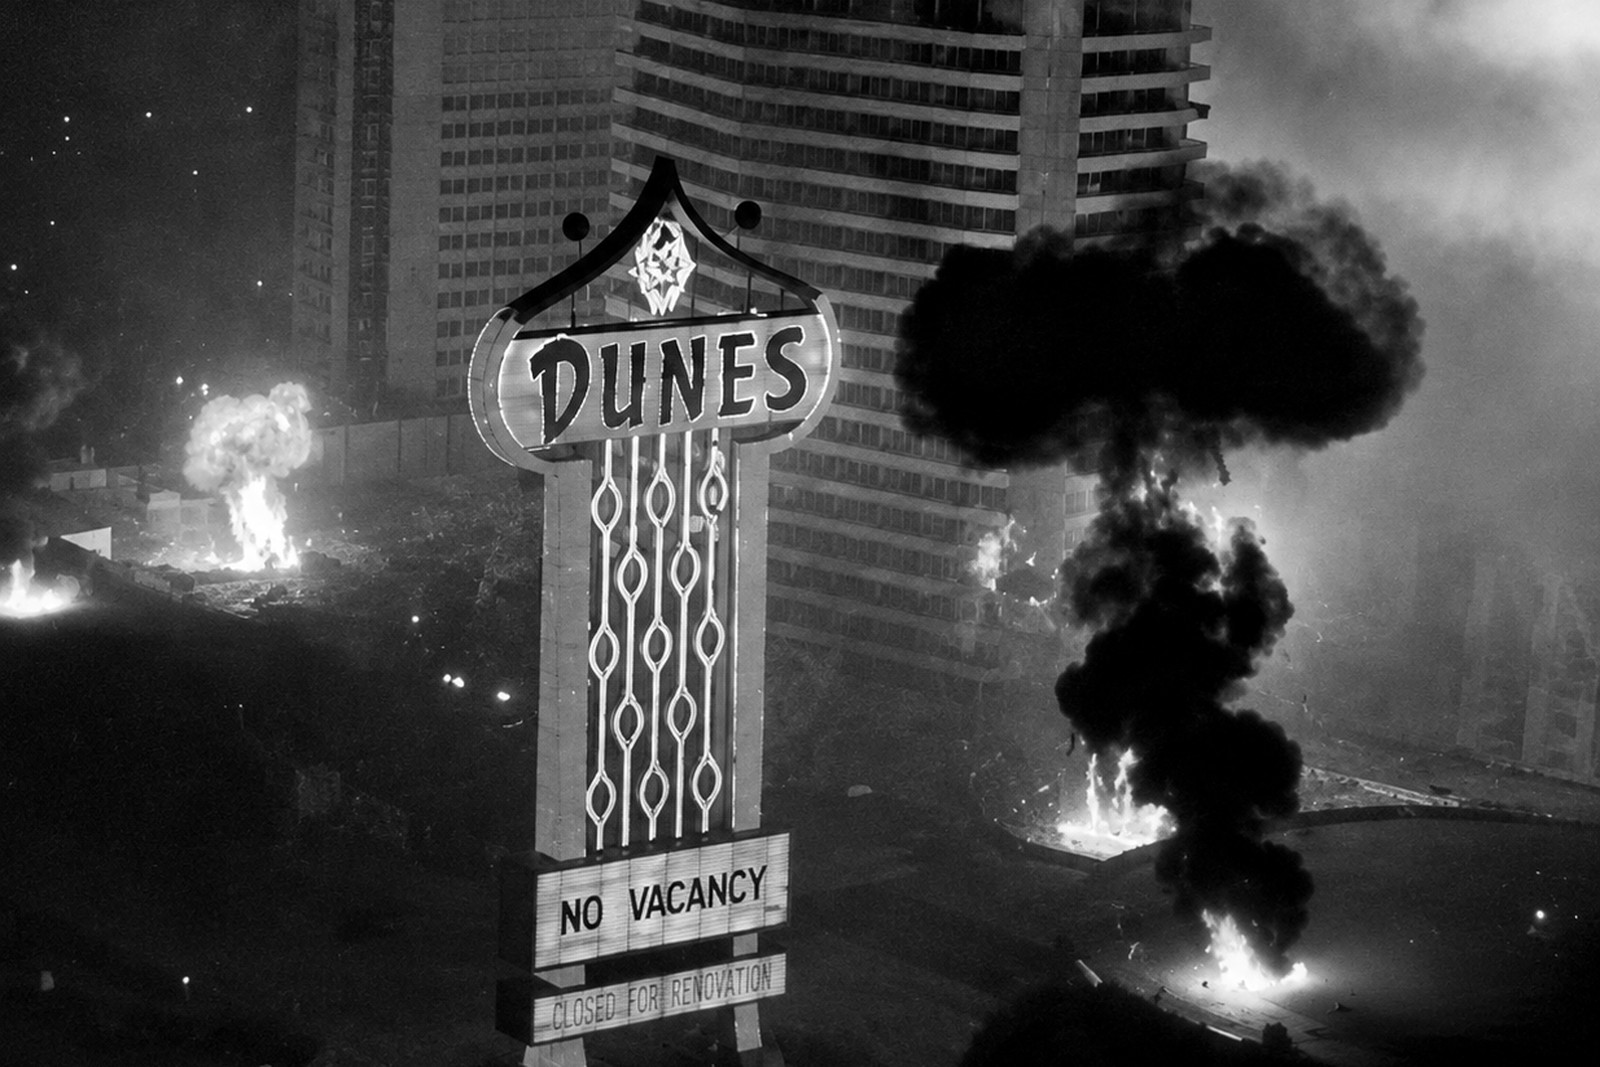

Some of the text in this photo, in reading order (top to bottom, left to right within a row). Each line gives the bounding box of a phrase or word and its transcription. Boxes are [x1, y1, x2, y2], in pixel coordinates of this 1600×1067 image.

[528, 324, 808, 445] DUNES
[560, 864, 768, 936] NO VACANCY
[552, 961, 772, 1031] CLOSED FOR RENOVATION
